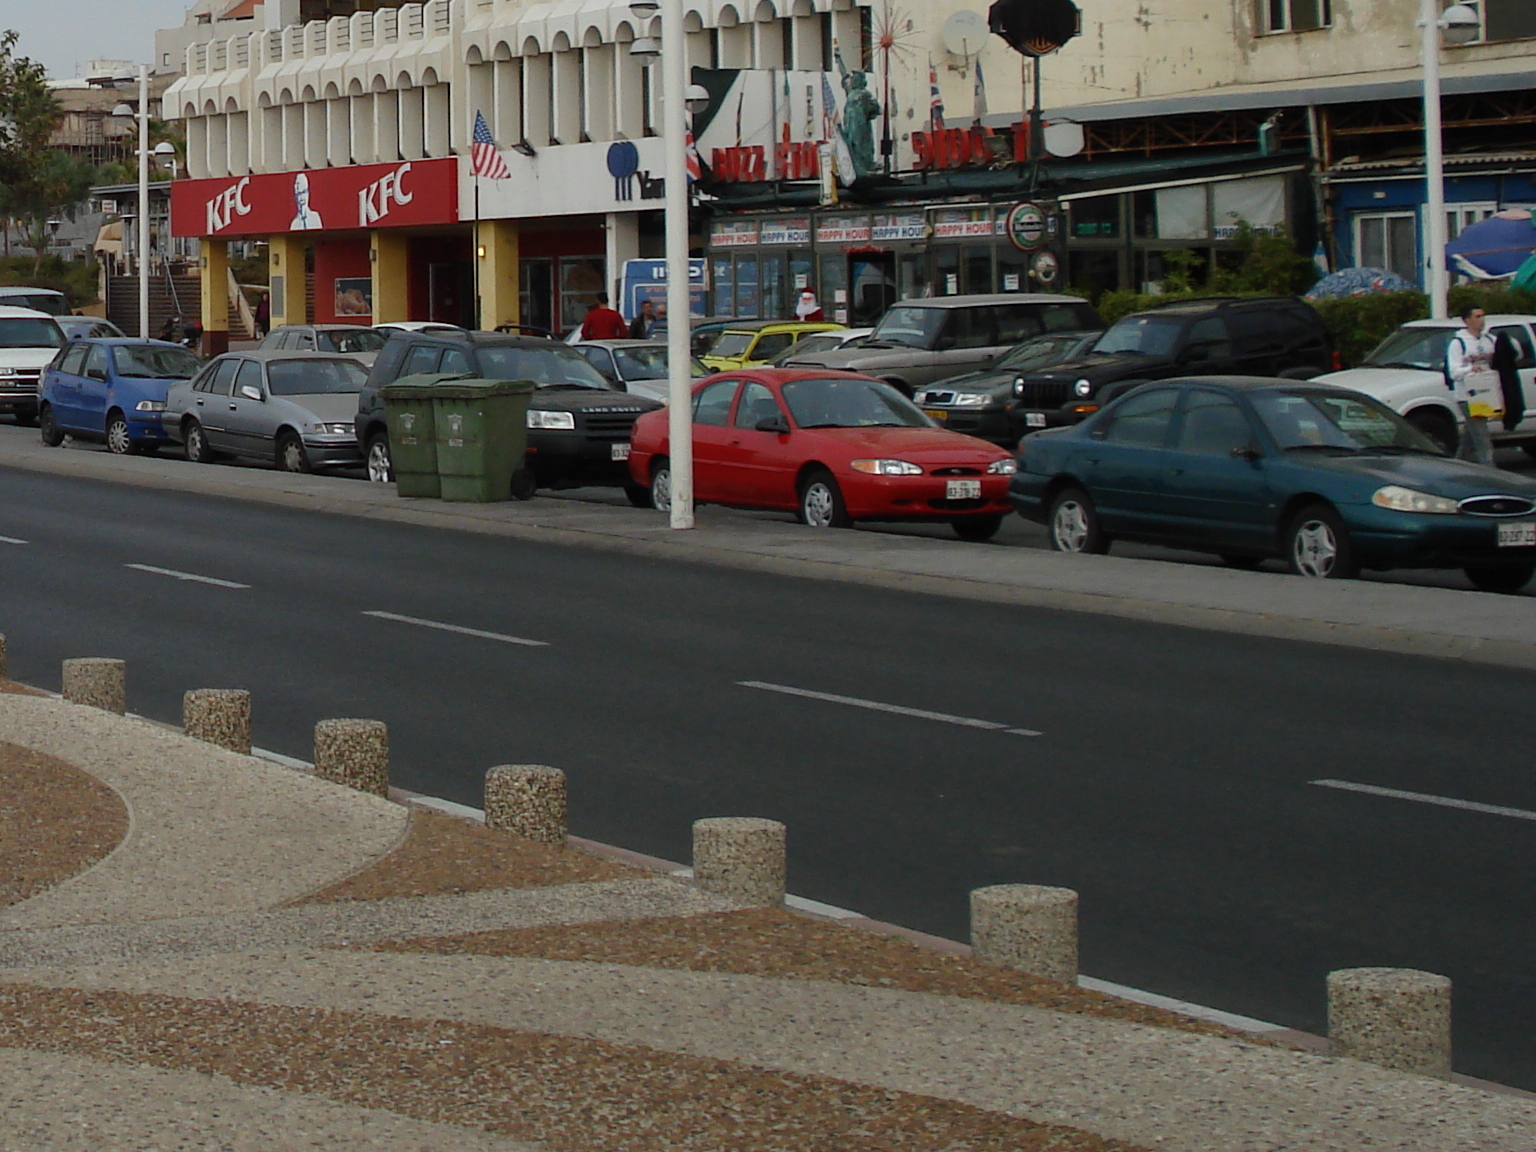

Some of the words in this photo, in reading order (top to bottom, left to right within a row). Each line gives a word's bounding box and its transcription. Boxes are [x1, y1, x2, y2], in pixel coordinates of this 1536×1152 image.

[774, 139, 830, 180] STO
[358, 162, 413, 227] KFC
[206, 177, 252, 235] KFC
[817, 229, 844, 242] HAPPY
[846, 227, 870, 240] HOUR
[873, 226, 900, 239] HAPPY
[935, 224, 963, 236] HAPPY
[966, 222, 991, 234] HOUR
[712, 234, 735, 246] HAPPY
[761, 231, 786, 243] HAPPY
